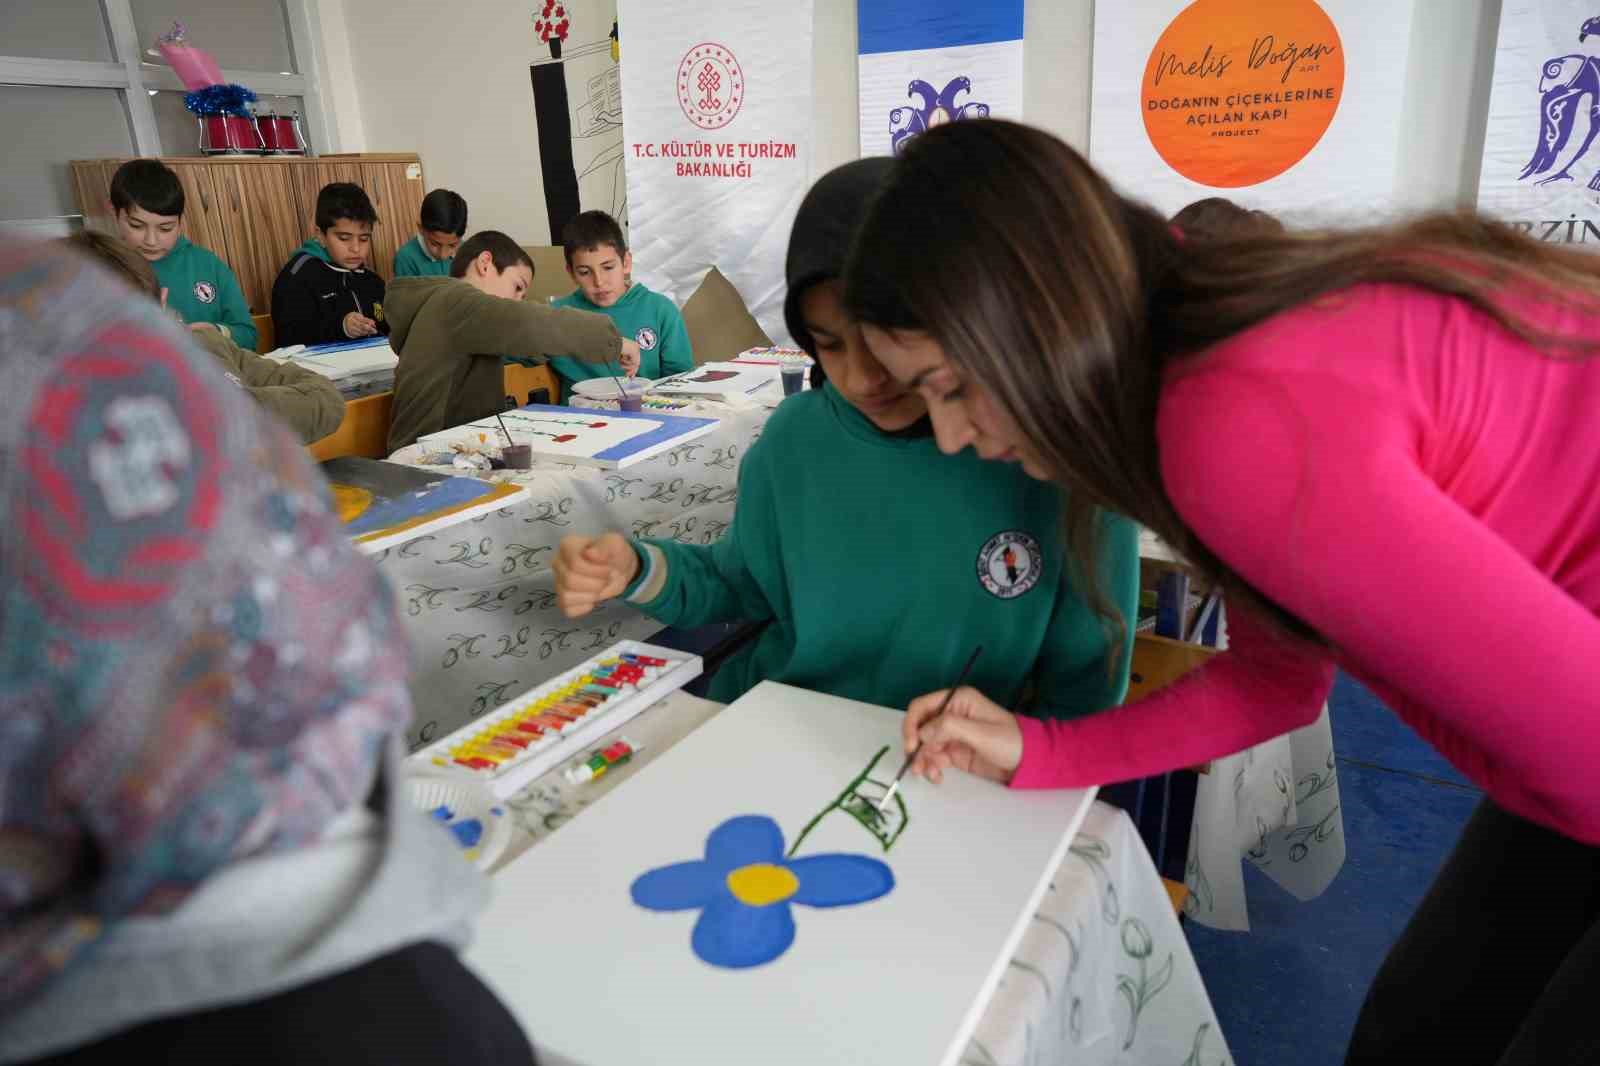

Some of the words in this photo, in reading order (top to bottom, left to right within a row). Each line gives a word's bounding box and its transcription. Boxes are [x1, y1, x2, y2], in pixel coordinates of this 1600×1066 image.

[1154, 45, 1232, 86] Melis
[1247, 35, 1335, 84] Doğan
[1225, 87, 1335, 108] ÇİÇEKLERİNE
[1186, 111, 1244, 127] AÇILAN
[1250, 109, 1288, 121] KAPI
[1211, 128, 1260, 137] PROJECT
[633, 143, 659, 157] T.C.
[661, 140, 712, 157] KÜLTÜR
[716, 143, 734, 157] VE
[738, 139, 796, 159] TURİZM
[676, 161, 751, 178] BAKANLIĞI
